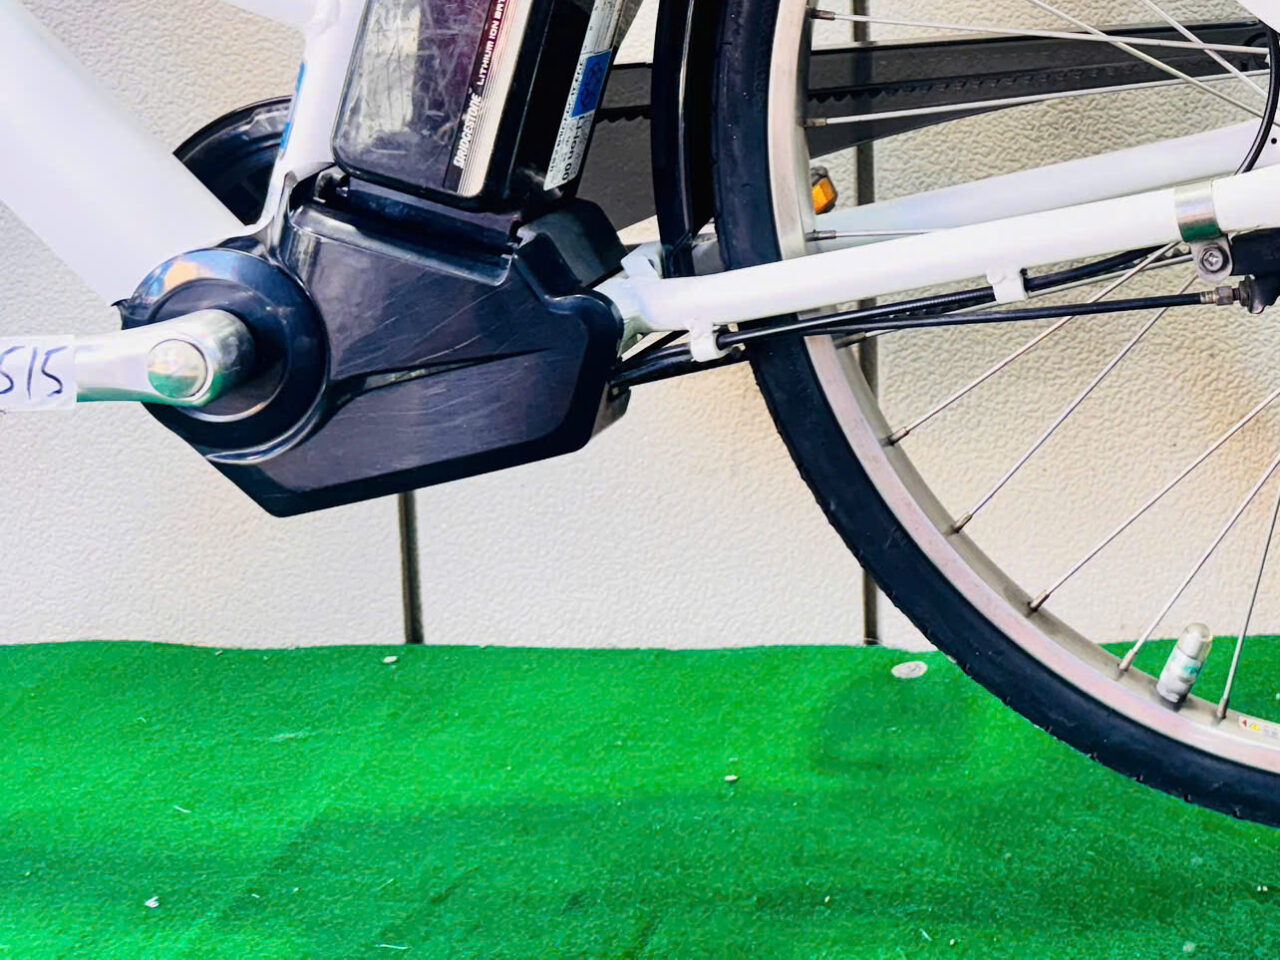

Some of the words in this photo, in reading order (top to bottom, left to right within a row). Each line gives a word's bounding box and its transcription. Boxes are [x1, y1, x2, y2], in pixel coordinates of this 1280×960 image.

[477, 39, 493, 86] LITHIUM
[488, 20, 500, 40] ION
[453, 92, 482, 169] BRIDGESTONE
